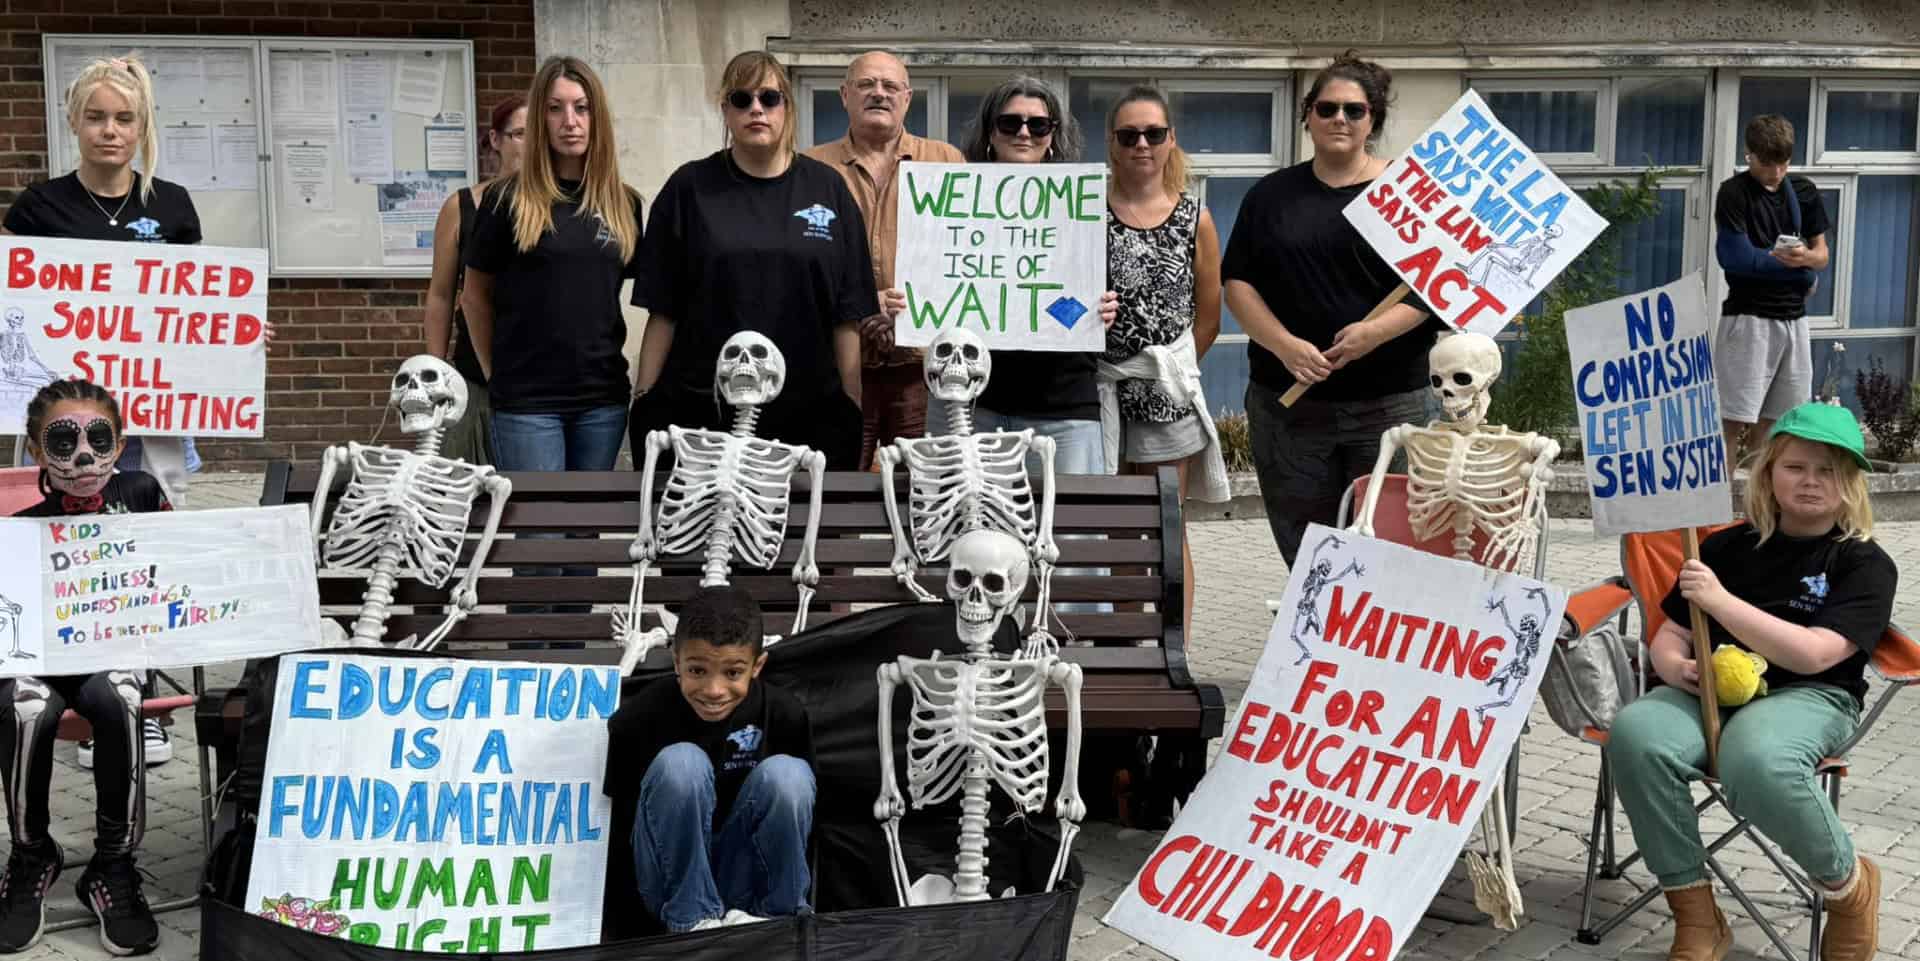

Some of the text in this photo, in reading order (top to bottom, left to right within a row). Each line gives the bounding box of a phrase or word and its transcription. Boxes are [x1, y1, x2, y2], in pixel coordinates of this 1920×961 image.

[1413, 131, 1538, 245] SAYS WAIT
[1454, 104, 1570, 225] THE LA
[907, 172, 1103, 221] WELCOME
[1367, 184, 1426, 244] SAYS
[1395, 156, 1494, 255] THE LAW
[943, 253, 1048, 279] ISLE OF
[947, 226, 1057, 248] TO THE
[7, 247, 255, 297] BONE TIRED
[1394, 246, 1507, 329] ACT
[43, 301, 262, 345] SOUL TIRED
[905, 281, 1064, 332] WAIT
[1624, 291, 1675, 350] NO
[68, 351, 172, 389] STILL
[1576, 330, 1714, 407] COMPASSION
[110, 391, 260, 430] IGHTING
[1586, 383, 1718, 456] LEFT IN THE
[1593, 434, 1727, 498] SEN SYSTEM
[50, 540, 136, 572] DESERVE
[1322, 585, 1507, 681] WAITING
[290, 661, 621, 721] EDUCATION
[1291, 660, 1496, 769] FOR AN
[391, 727, 513, 774] IS A
[1226, 702, 1480, 825] EDUCATION
[268, 774, 601, 846] FUNDAMENTAL
[1254, 780, 1413, 855] SHOULDN'T
[1248, 814, 1368, 885] TAKE A
[330, 853, 552, 910] HUMAN
[1138, 834, 1393, 961] CHILDHOOD
[348, 914, 551, 952] RIGHT
